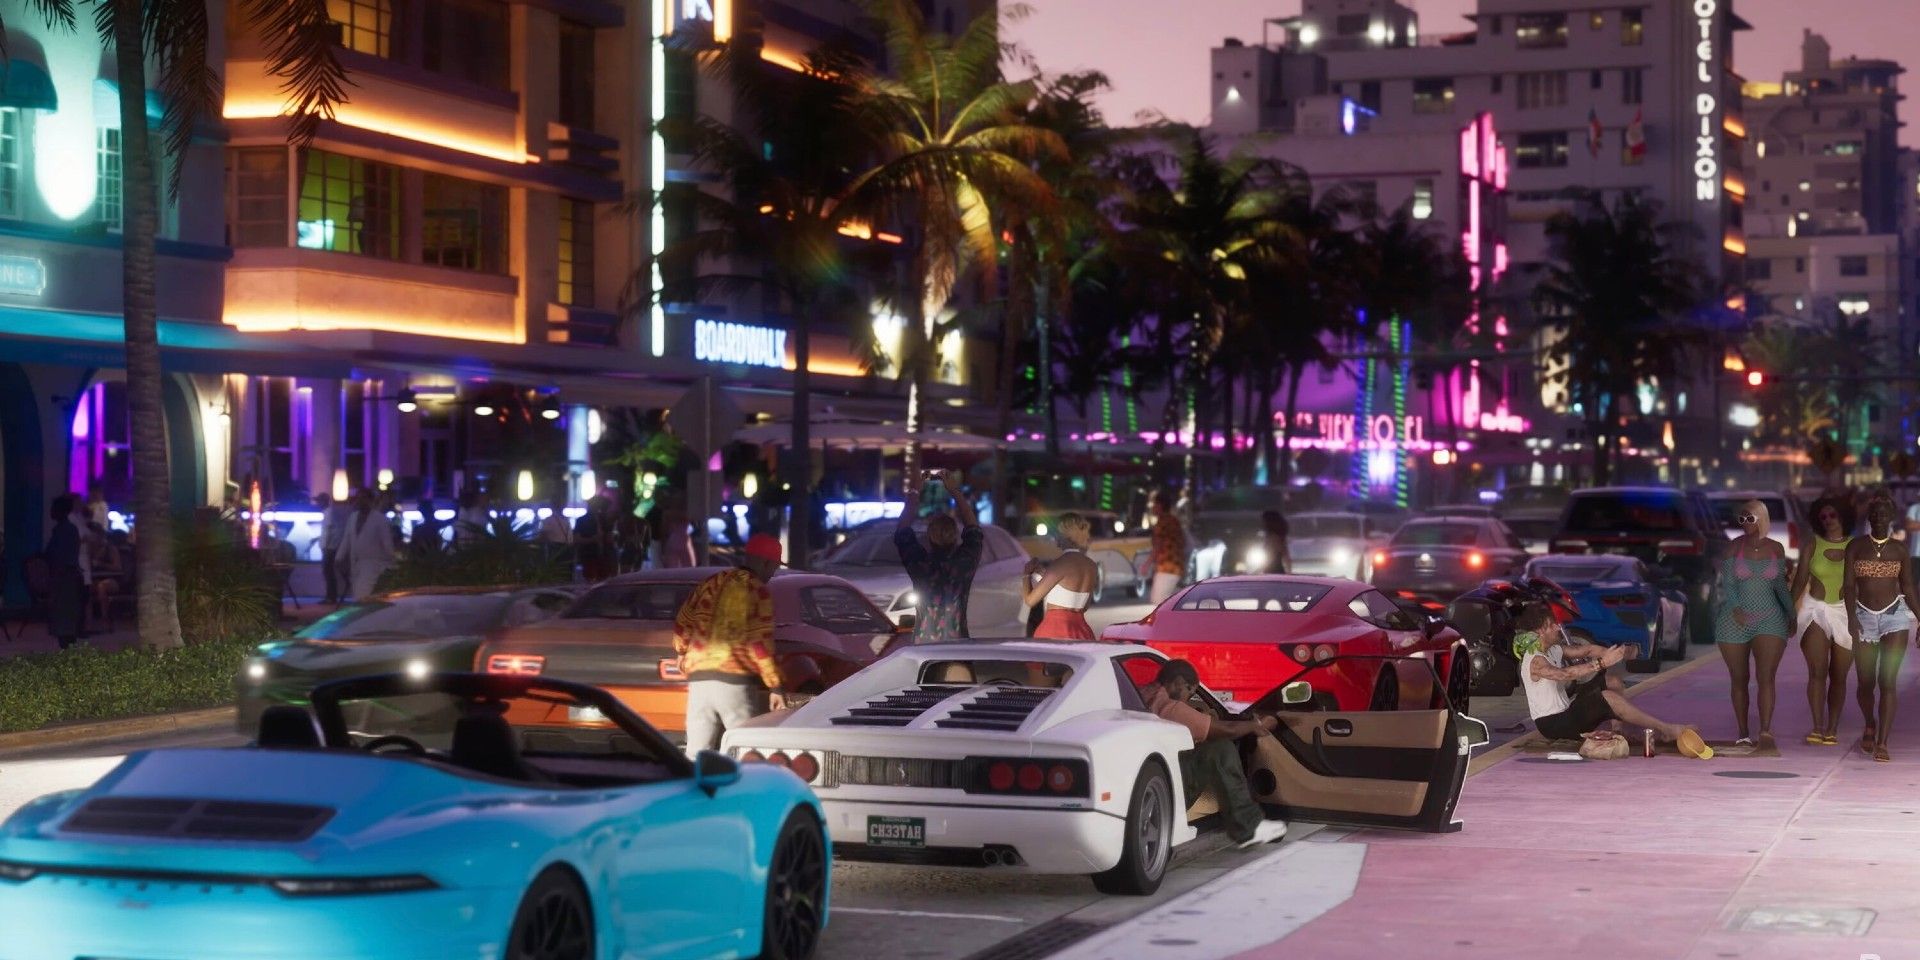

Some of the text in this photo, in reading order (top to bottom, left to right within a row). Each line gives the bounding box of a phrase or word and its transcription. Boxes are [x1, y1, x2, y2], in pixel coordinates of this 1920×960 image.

[1694, 93, 1717, 200] DIXON
[695, 319, 787, 368] BOARDWALK
[1361, 414, 1422, 442] OEL
[870, 824, 921, 839] CH33TAH
